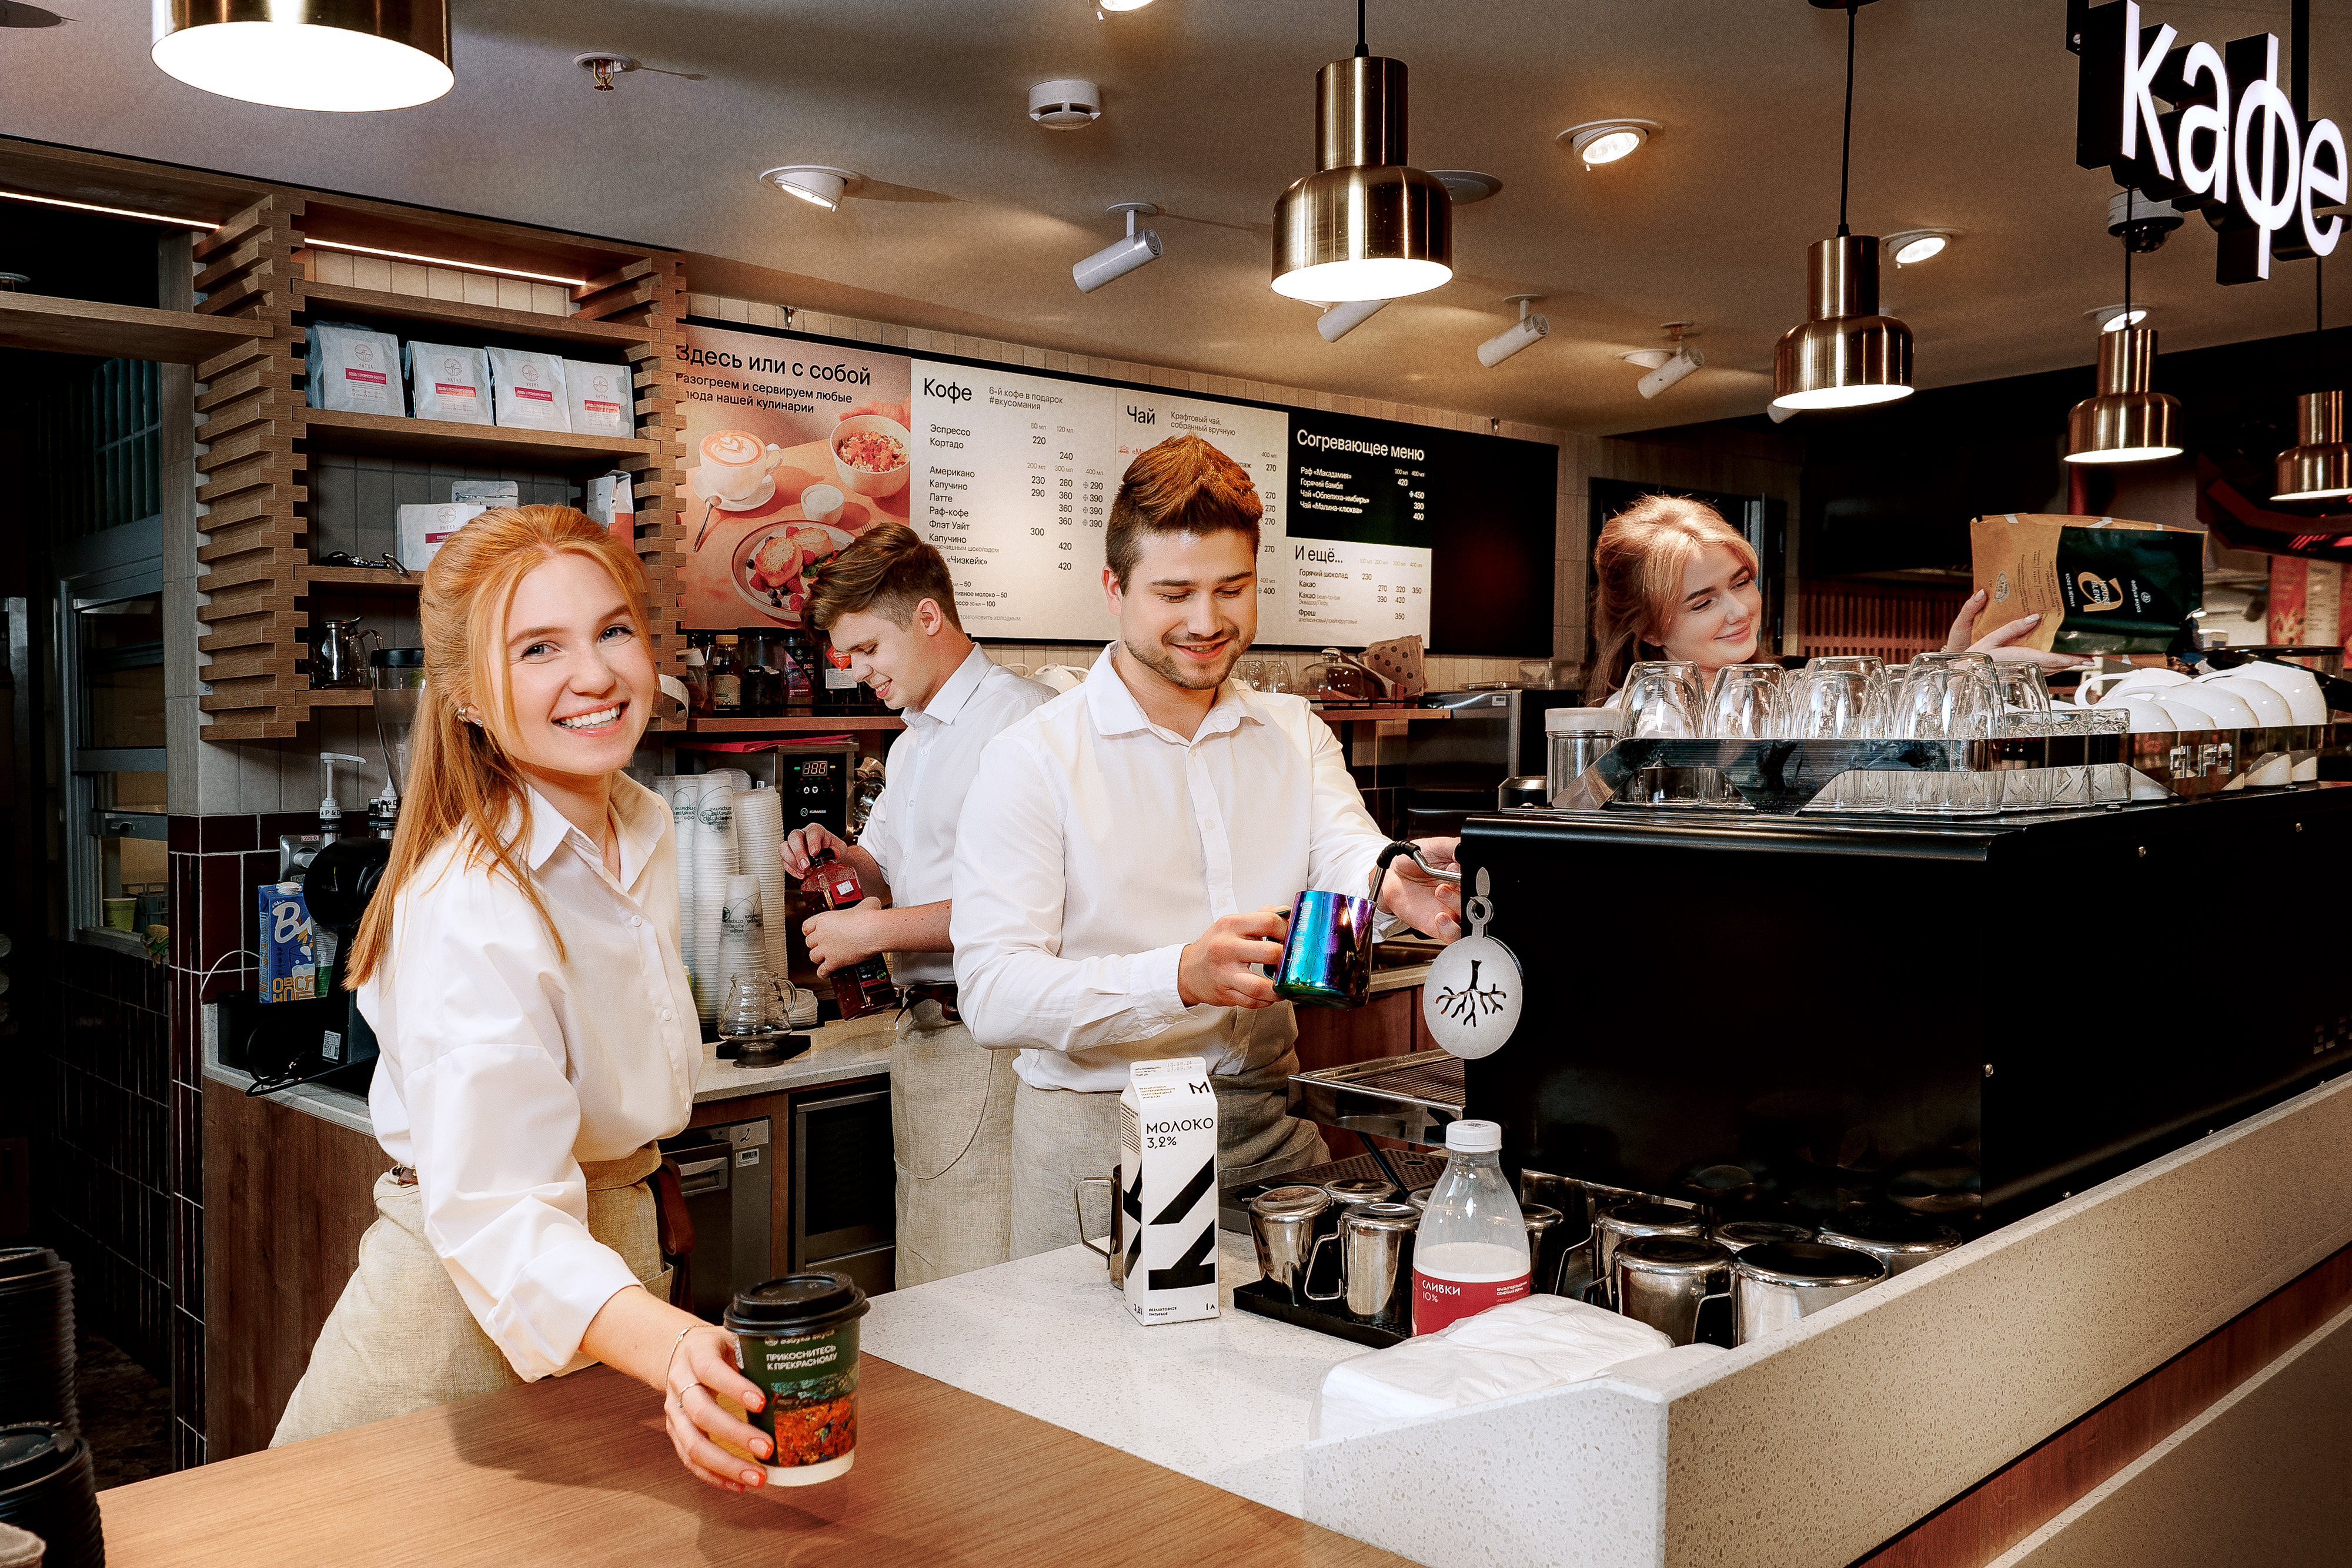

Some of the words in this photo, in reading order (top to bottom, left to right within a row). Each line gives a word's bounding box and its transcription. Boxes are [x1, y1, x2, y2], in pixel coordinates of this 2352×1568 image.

[2122, 0, 2348, 280] кафе
[676, 343, 743, 369] Здесь
[749, 356, 785, 375] или
[792, 363, 803, 377] с
[810, 364, 870, 386] собой
[743, 382, 749, 390] и
[753, 383, 813, 399] сервируем
[816, 390, 852, 403] любые
[924, 377, 972, 404] Кофе
[989, 386, 1002, 396] 6-й
[1004, 390, 1024, 400] кофе
[1032, 394, 1063, 404] подарок
[717, 394, 753, 406] нашей
[757, 398, 814, 413] кулинарии
[989, 396, 1041, 410] #вкусомания
[1127, 405, 1155, 424] Чай
[1171, 412, 1207, 424] Крафтовый
[930, 424, 971, 437] Эспрессо
[1171, 421, 1207, 432] собранный
[1208, 426, 1235, 436] вручную
[930, 437, 964, 449] Кортадо
[1033, 436, 1045, 444] 220
[1297, 429, 1388, 456] Согревающее
[1391, 446, 1424, 461] меню
[1060, 452, 1073, 460] 240
[1266, 463, 1277, 472] 270
[1301, 467, 1312, 476] Раф
[930, 466, 975, 478] Американо
[1031, 476, 1045, 484] 230
[1060, 479, 1073, 487] 260
[1090, 482, 1103, 490] 290
[1301, 478, 1324, 487] Горячий
[930, 479, 968, 491] Капучино
[1031, 489, 1045, 497] 290
[1059, 492, 1073, 500] 360
[1090, 494, 1103, 503] 390
[1300, 489, 1312, 498] Чай
[930, 493, 953, 502] Латте
[1059, 504, 1073, 513] 360
[1090, 507, 1102, 515] 390
[1300, 501, 1311, 509] Чай
[929, 506, 968, 518] Раф-кофе
[1058, 517, 1072, 526] 360
[1089, 520, 1102, 528] 390
[929, 520, 950, 529] Флэт
[951, 521, 970, 530] Уайт
[1030, 527, 1044, 536] 300
[929, 533, 967, 544] Капучино
[1058, 542, 1072, 550] 420
[1295, 544, 1304, 560] И
[1308, 548, 1343, 564] ещё...
[947, 556, 987, 565] «Чизкейк»
[1058, 562, 1071, 571] 420
[1299, 569, 1322, 577] Горячий
[1324, 571, 1348, 579] шоколад
[2091, 580, 2102, 604] BLEND
[2100, 580, 2111, 606] HOUSE
[1147, 1118, 1214, 1134] МОЛОКО
[1147, 1136, 1177, 1149] 3,2%
[1422, 1279, 1461, 1296] СЛИВКИ
[1422, 1291, 1438, 1302] 10%
[766, 1345, 836, 1361] ПРИКОСНИТЕСЬ
[774, 1352, 837, 1370] ПРЕКРАСНОМУ
